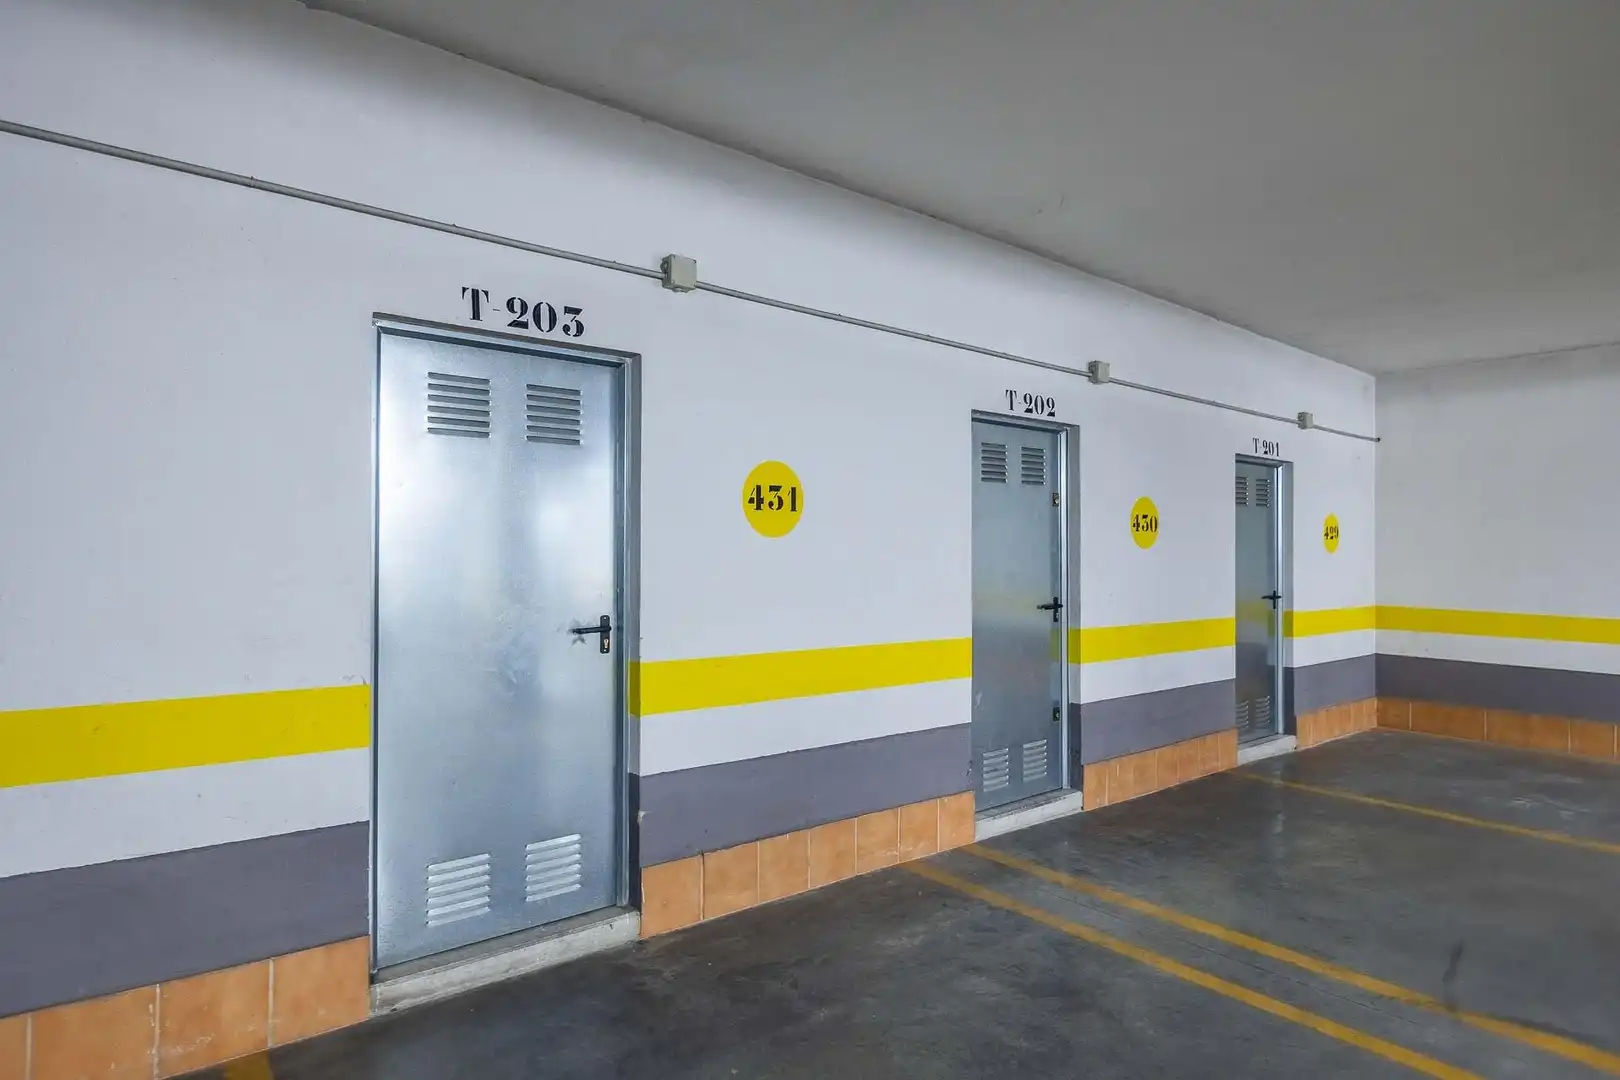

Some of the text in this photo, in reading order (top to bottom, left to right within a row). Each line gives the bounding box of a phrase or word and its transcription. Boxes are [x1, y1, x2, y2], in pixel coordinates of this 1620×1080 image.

[461, 286, 585, 337] T-203
[1005, 389, 1056, 418] T-202
[1252, 438, 1280, 457] T-201
[747, 484, 798, 512] 431
[1132, 514, 1158, 532] 430
[1324, 525, 1339, 540] 429
